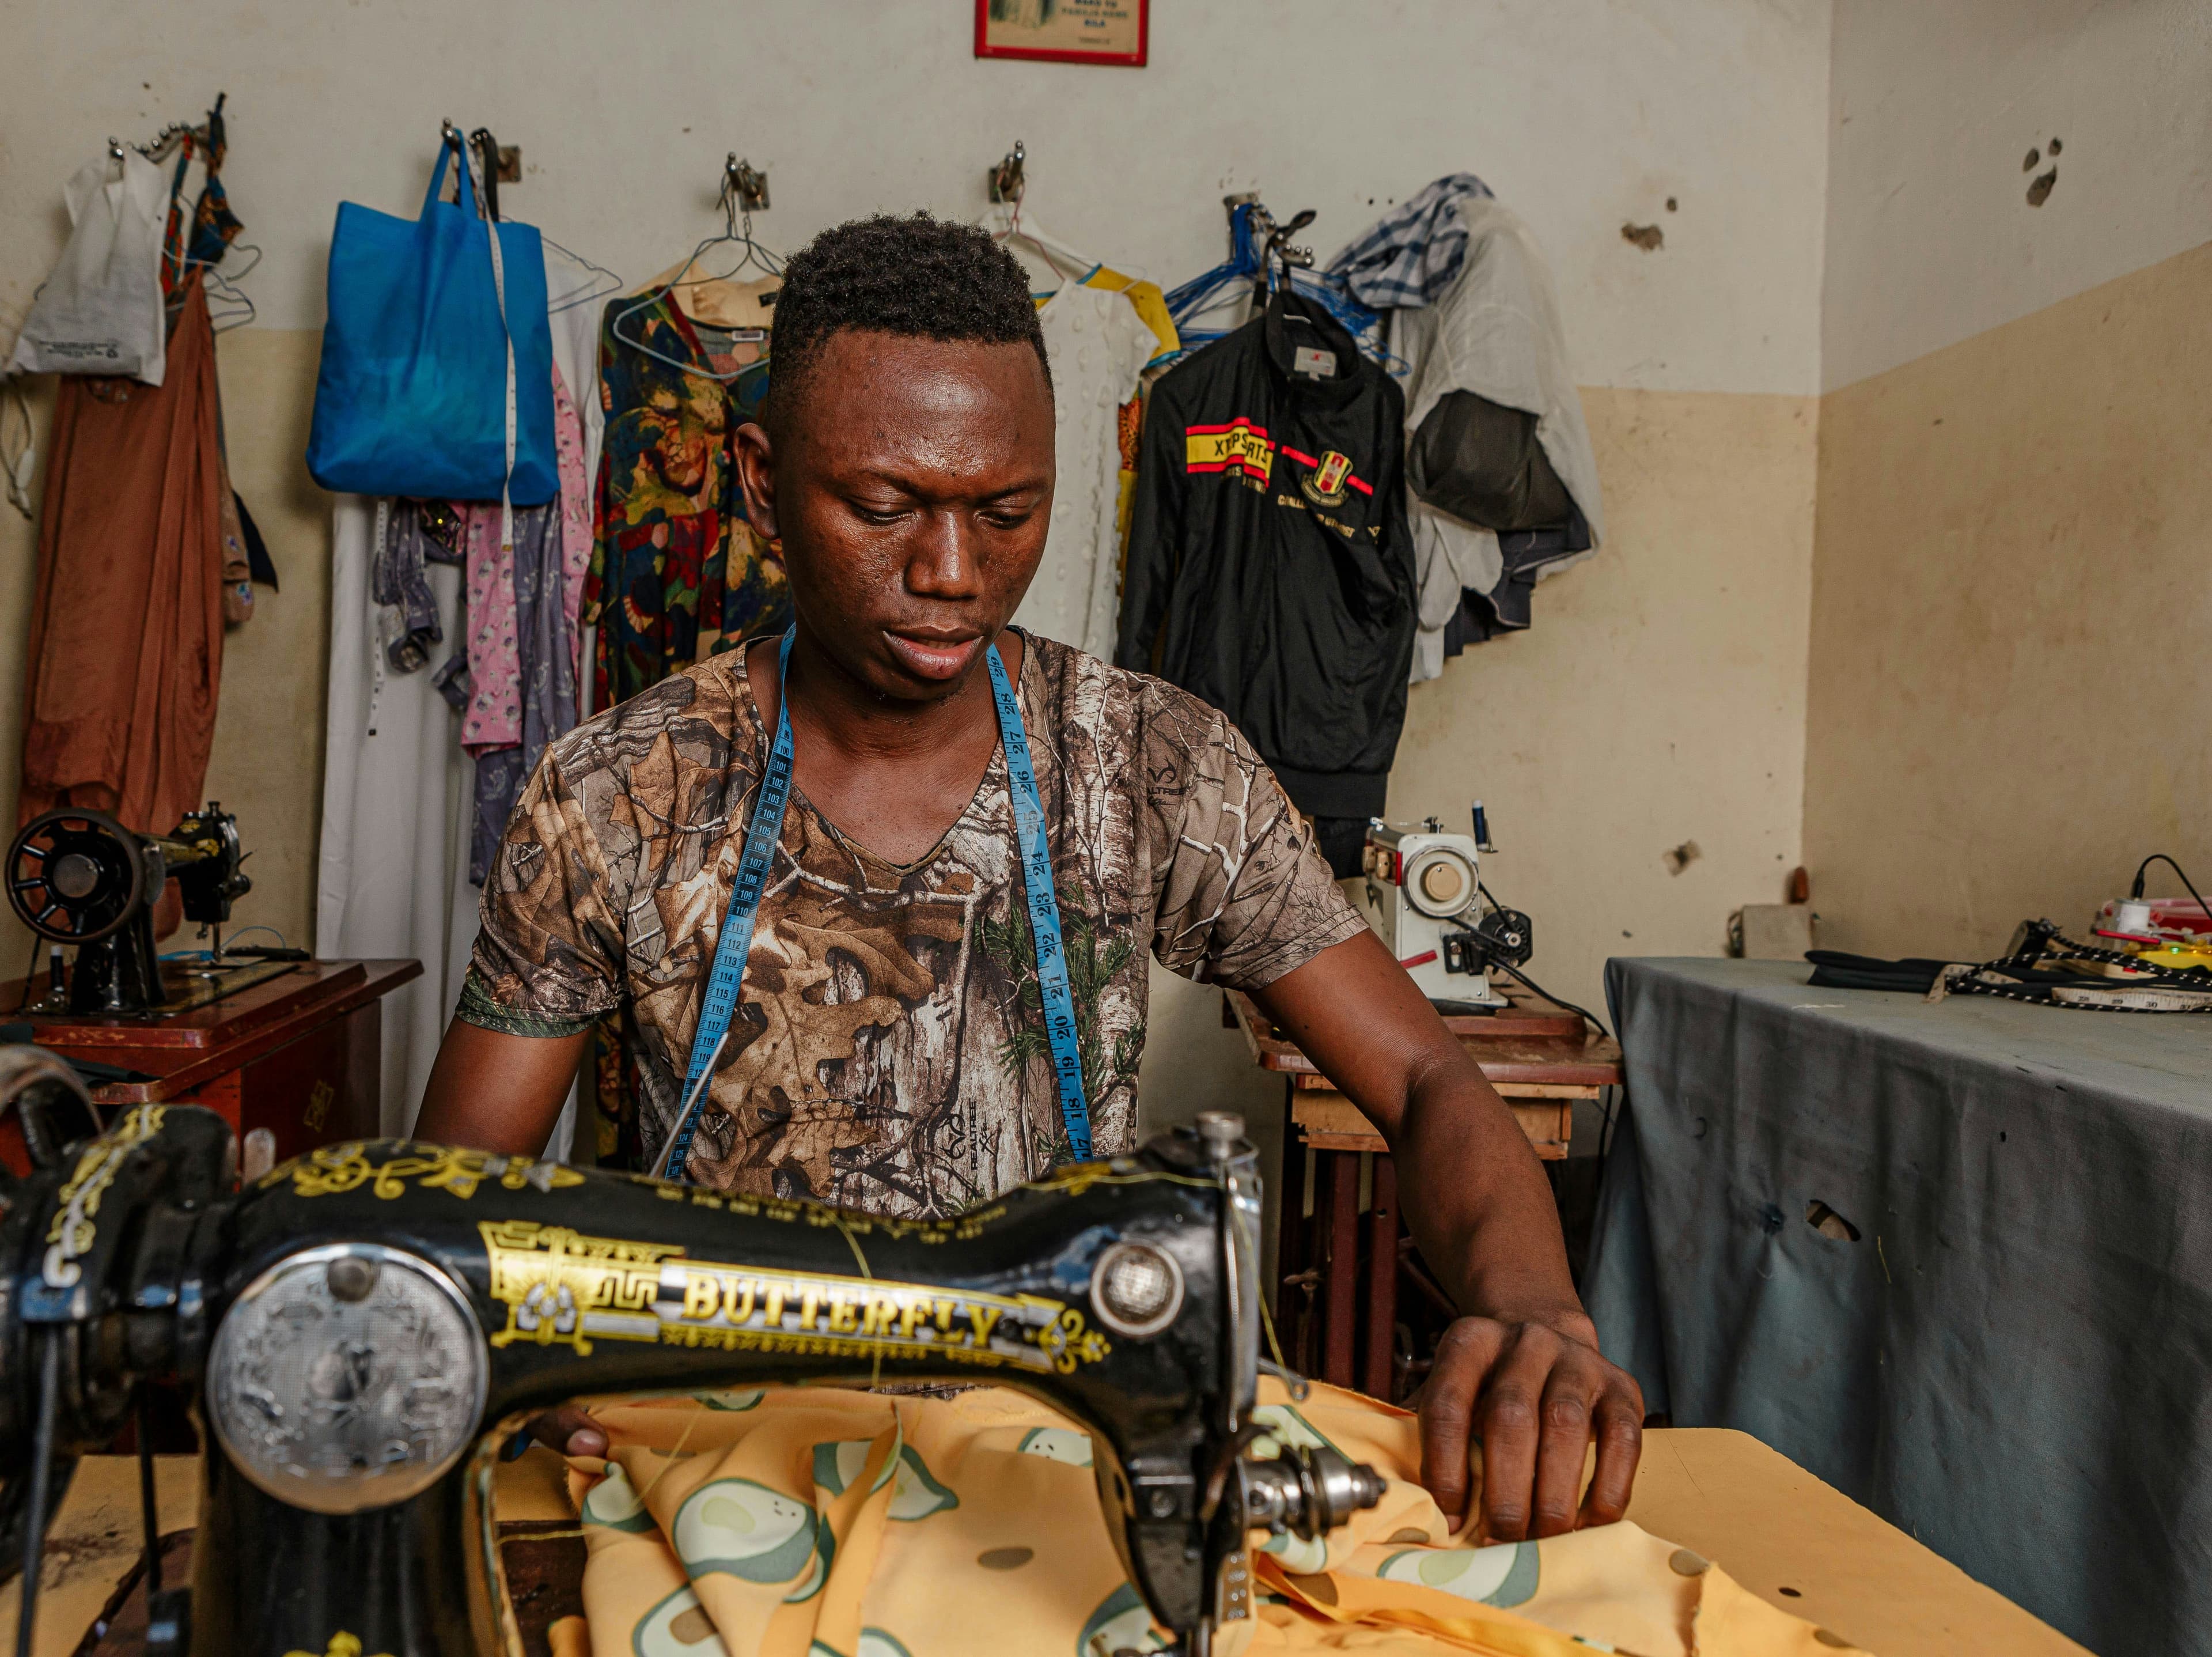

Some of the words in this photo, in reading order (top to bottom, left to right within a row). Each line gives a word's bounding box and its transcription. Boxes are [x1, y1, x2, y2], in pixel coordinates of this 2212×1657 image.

[990, 656, 1004, 678] 29
[1001, 693, 1016, 715] 28
[1010, 731, 1024, 755] 27
[780, 745, 789, 756] 100
[776, 761, 786, 773] 101
[772, 777, 783, 789] 102
[1017, 770, 1033, 794] 26
[768, 792, 780, 804] 103
[763, 808, 775, 820] 104
[1024, 810, 1040, 835] 25
[759, 824, 771, 836] 105
[754, 841, 767, 852] 106
[749, 857, 763, 868] 107
[1031, 850, 1046, 876] 24
[745, 873, 758, 884] 108
[740, 890, 753, 901] 109
[1036, 892, 1051, 916] 23
[736, 906, 748, 917] 110
[732, 922, 744, 933] 111
[728, 938, 741, 949] 112
[1043, 932, 1058, 958] 22
[724, 955, 737, 966] 113
[719, 971, 733, 982] 114
[1048, 974, 1065, 999] 21
[715, 988, 729, 998] 115
[711, 1004, 725, 1015] 116
[707, 1019, 721, 1030] 117
[1054, 1016, 1071, 1040] 20
[703, 1036, 715, 1047] 118
[699, 1053, 711, 1062] 119
[1062, 1056, 1075, 1079] 19
[1068, 1098, 1083, 1120] 18
[679, 1133, 688, 1142] 124
[969, 1098, 978, 1170] REALTREE
[681, 1272, 1003, 1346] BUTTERFLY
